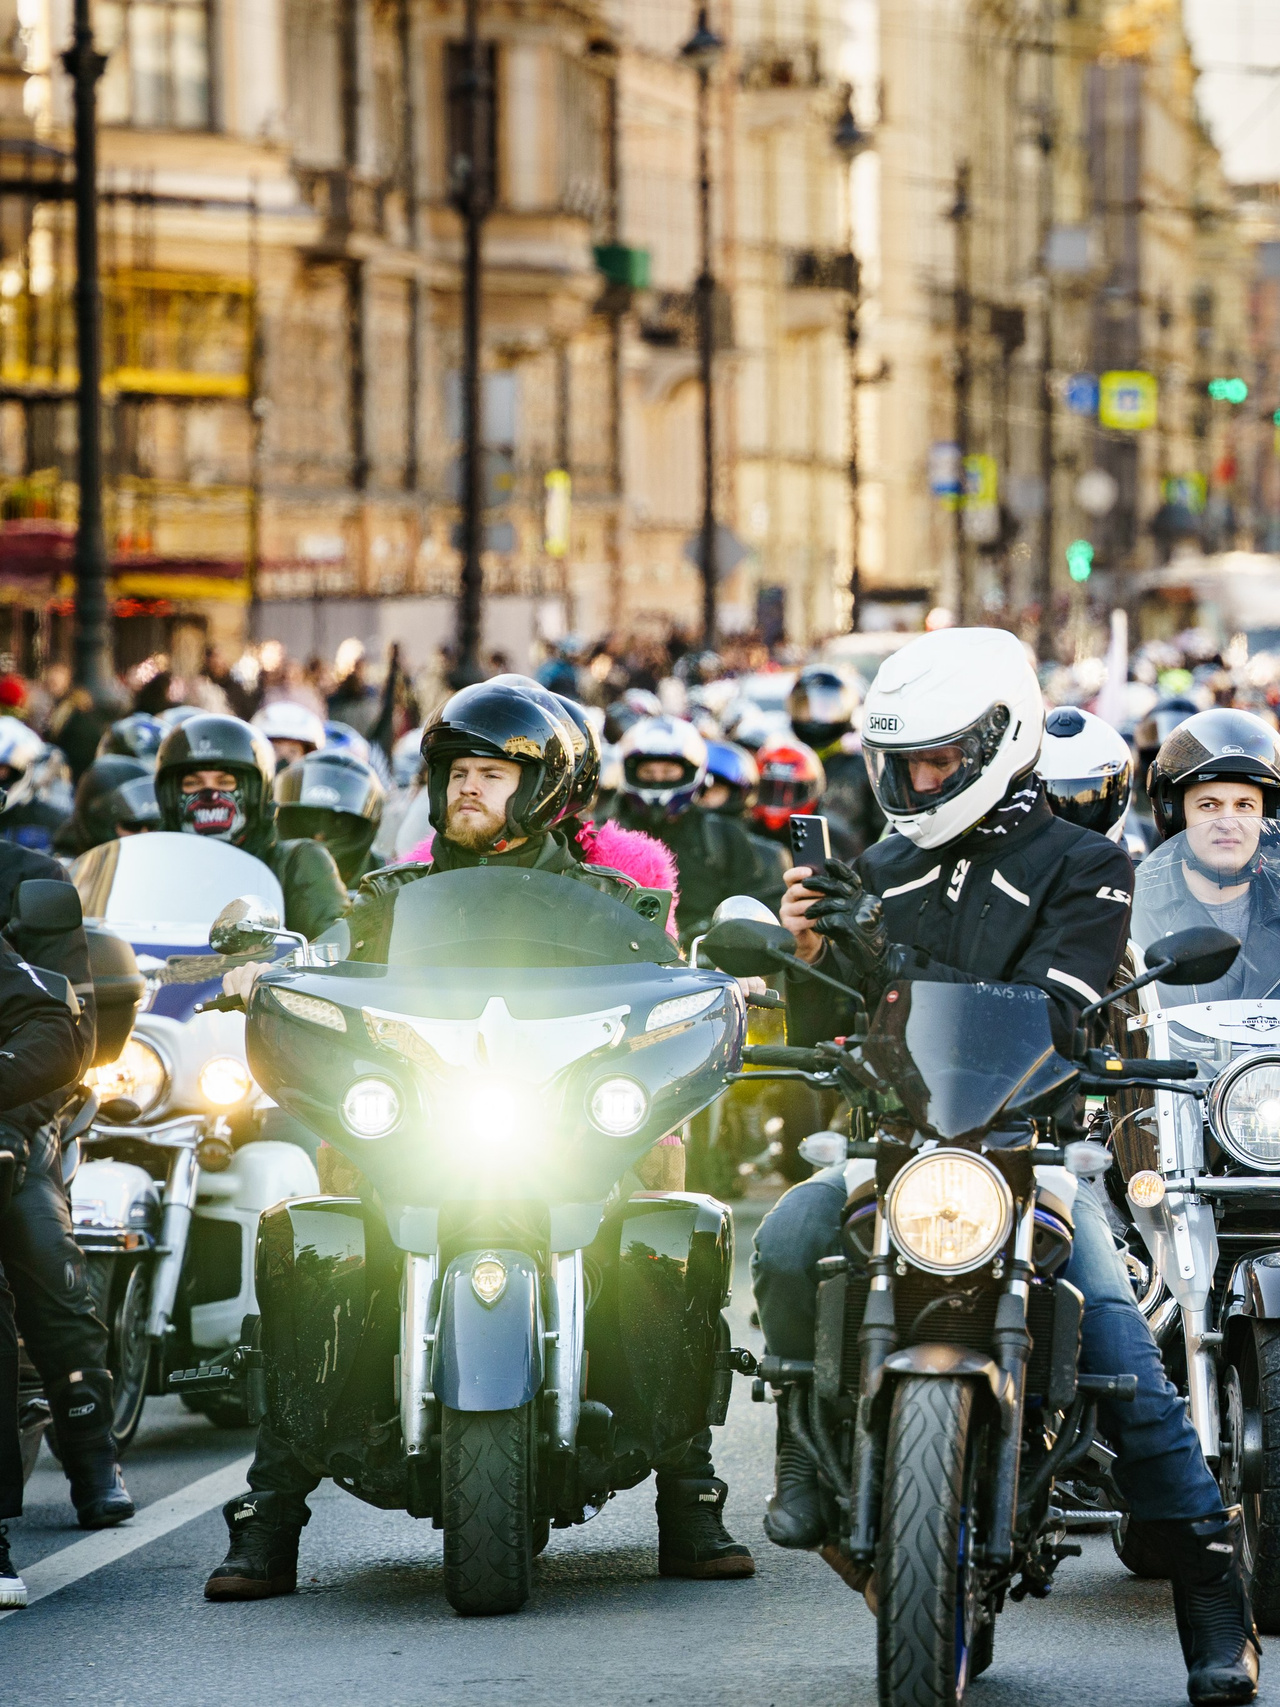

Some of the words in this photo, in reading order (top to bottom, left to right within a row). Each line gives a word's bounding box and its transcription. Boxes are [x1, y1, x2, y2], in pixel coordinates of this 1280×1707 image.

[870, 716, 897, 731] SHOEI
[946, 858, 971, 902] LS2
[234, 1509, 254, 1521] PUMA
